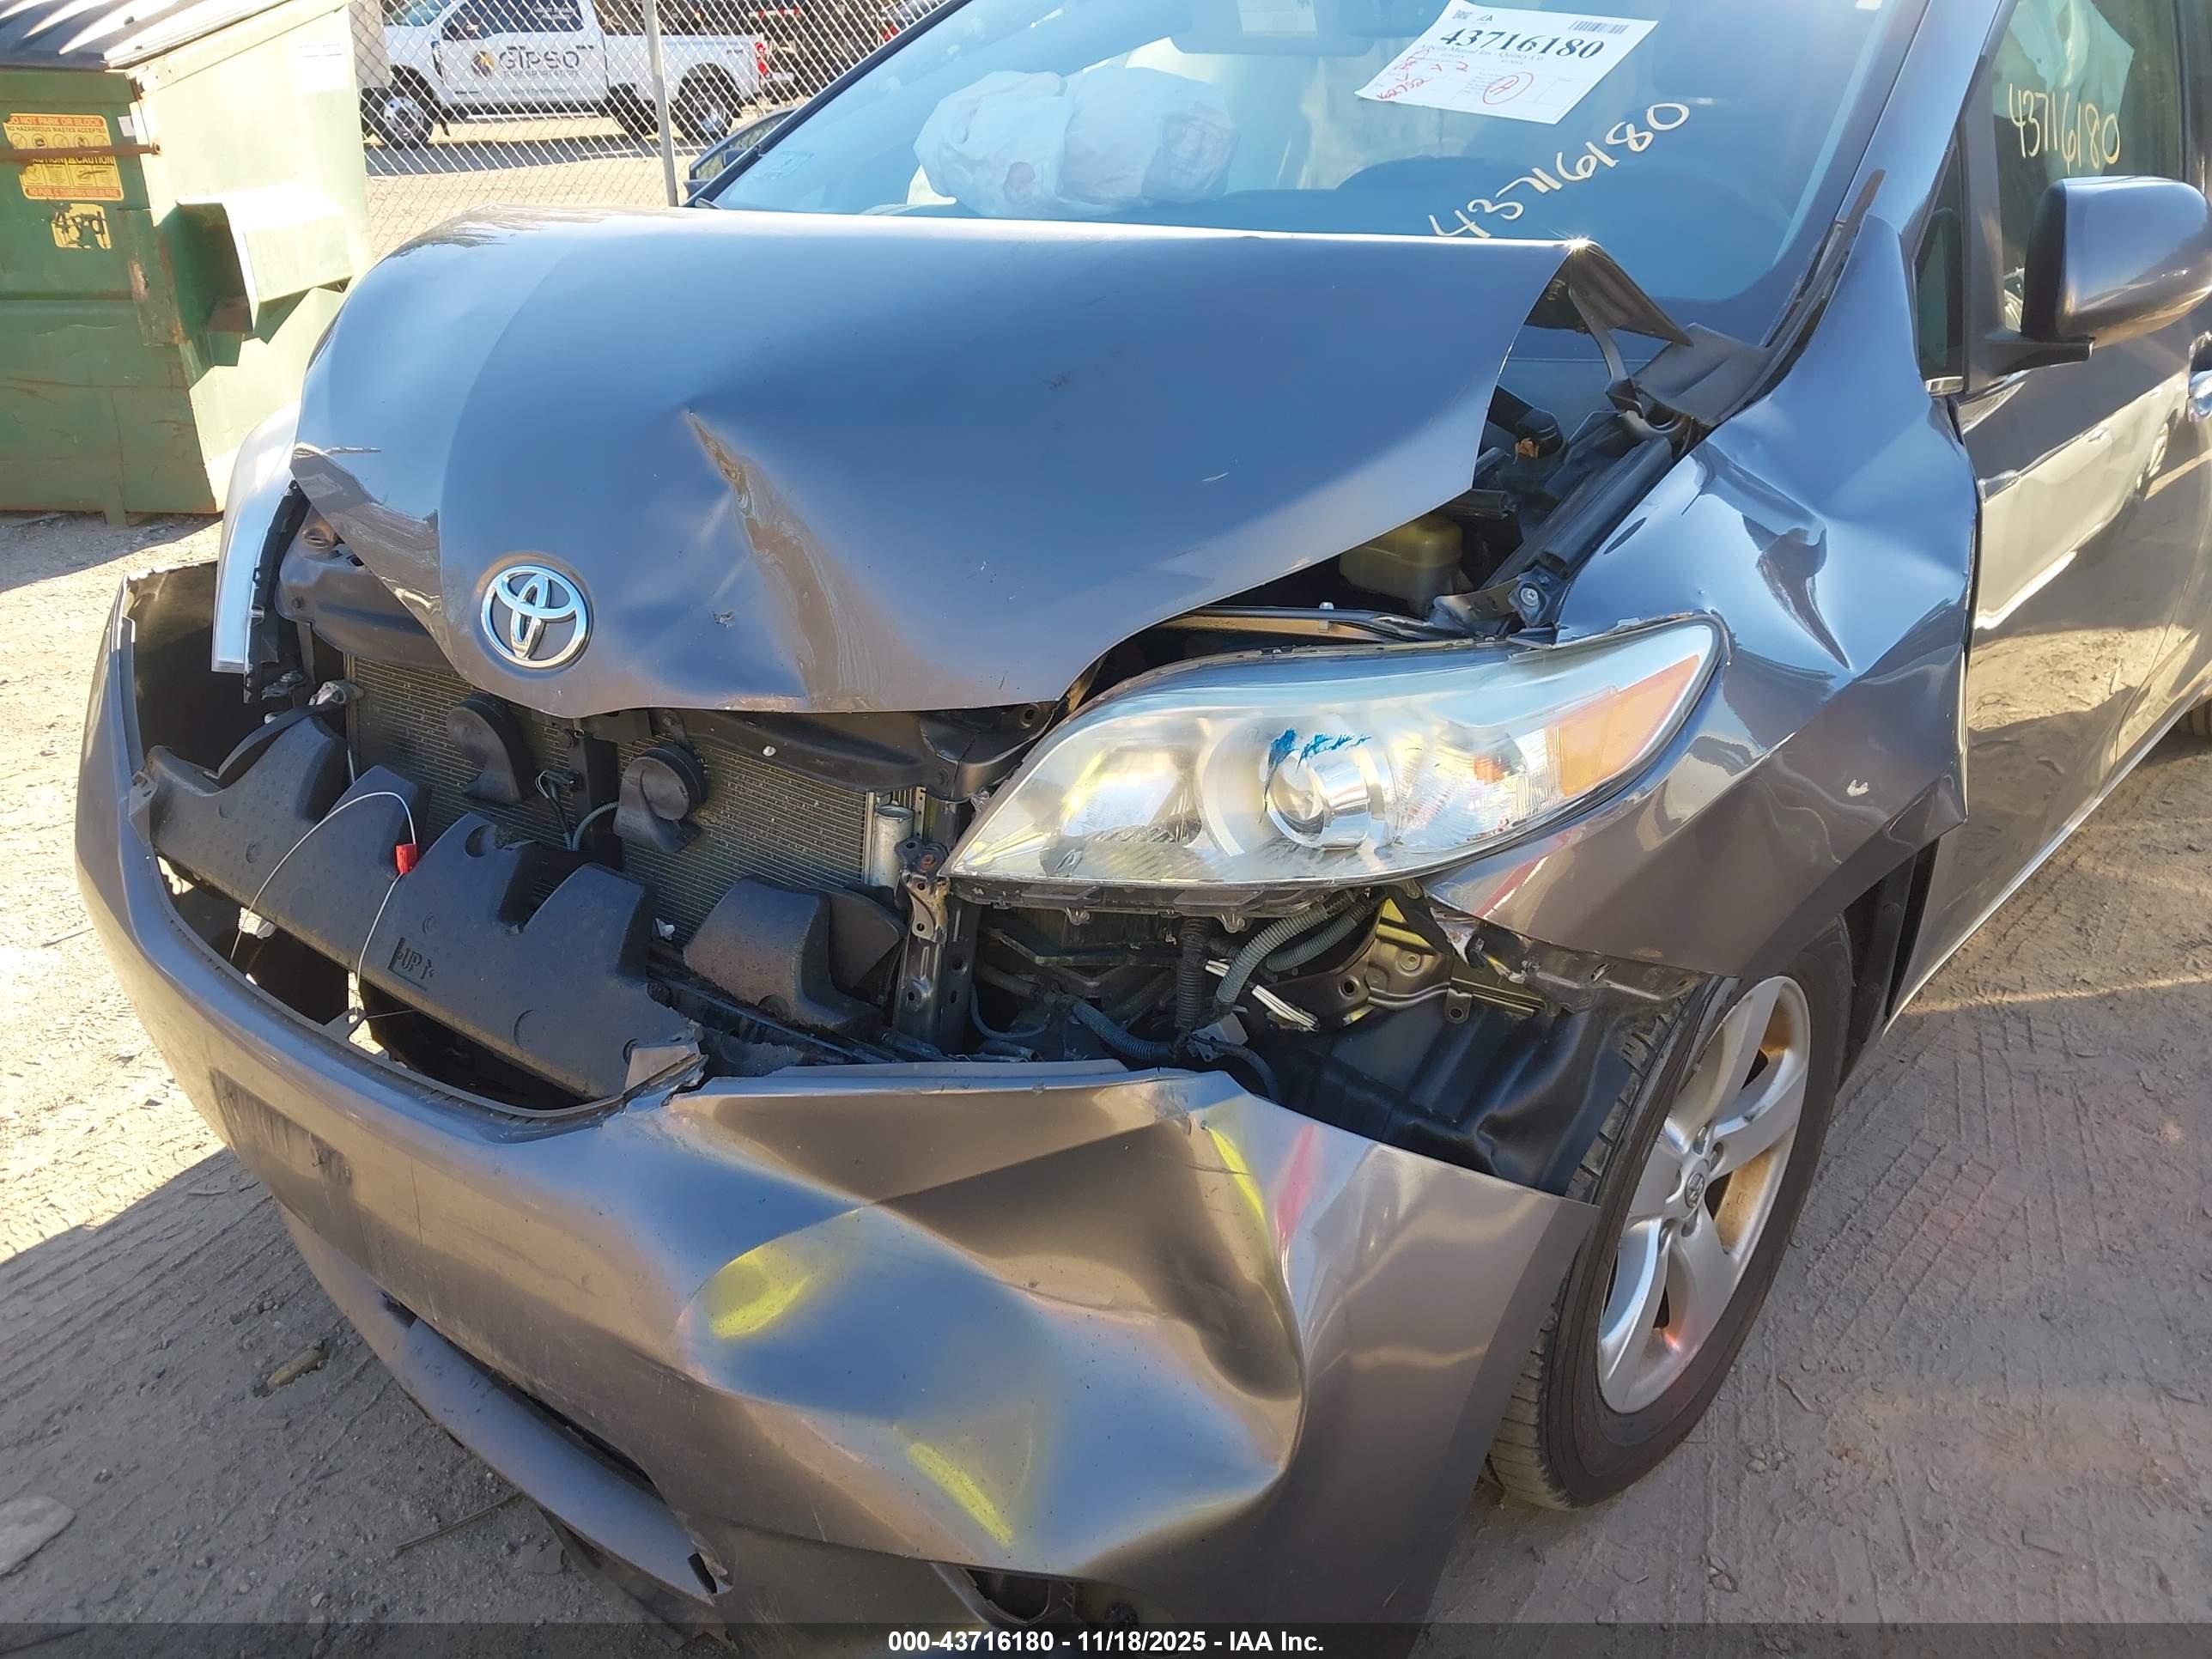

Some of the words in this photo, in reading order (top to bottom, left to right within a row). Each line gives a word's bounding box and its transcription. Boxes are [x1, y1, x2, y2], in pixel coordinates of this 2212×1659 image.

[1440, 28, 1604, 59] 43716180
[39, 117, 59, 125] PARK
[2008, 83, 2120, 175] 43716180
[76, 155, 112, 164] CAUTION
[1428, 103, 1690, 238] 43716180
